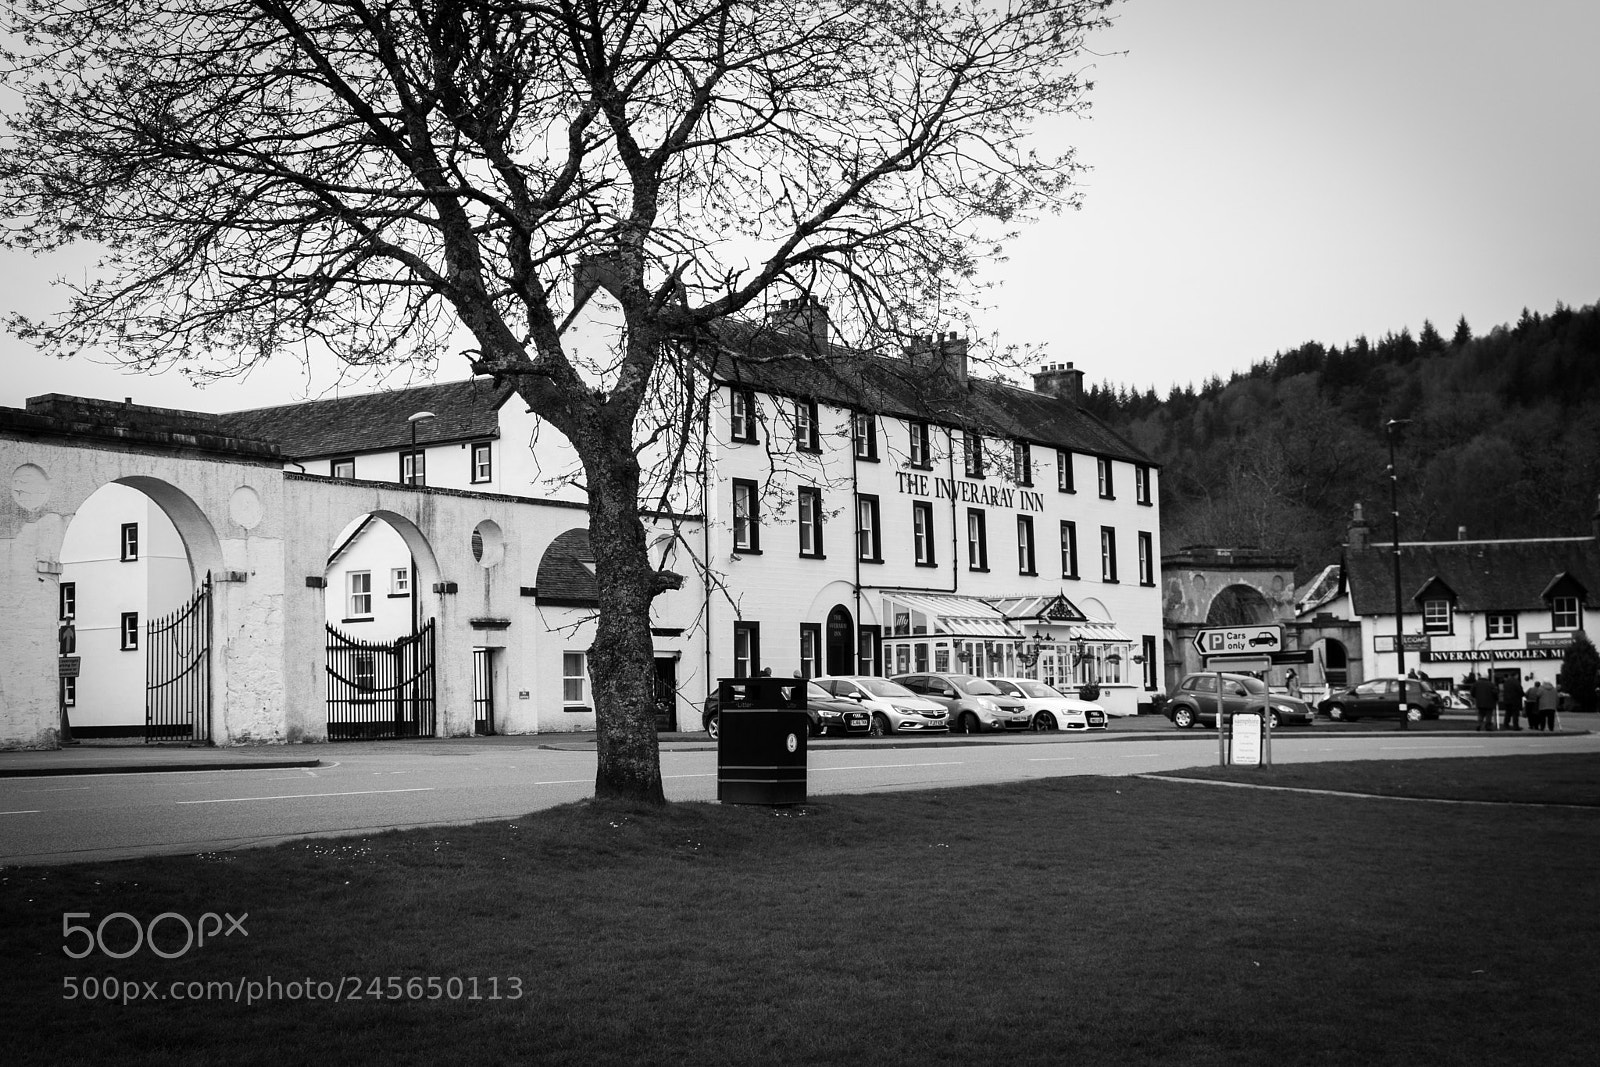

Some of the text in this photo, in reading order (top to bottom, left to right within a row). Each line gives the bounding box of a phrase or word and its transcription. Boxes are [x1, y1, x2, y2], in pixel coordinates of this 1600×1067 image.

[896, 471, 1044, 513] THE INVERARAY INN
[896, 615, 909, 628] illy
[1212, 632, 1246, 649] P Cars
[1227, 641, 1246, 651] only
[1430, 651, 1491, 661] INVERARAY
[1494, 649, 1547, 660] WOOLLEN
